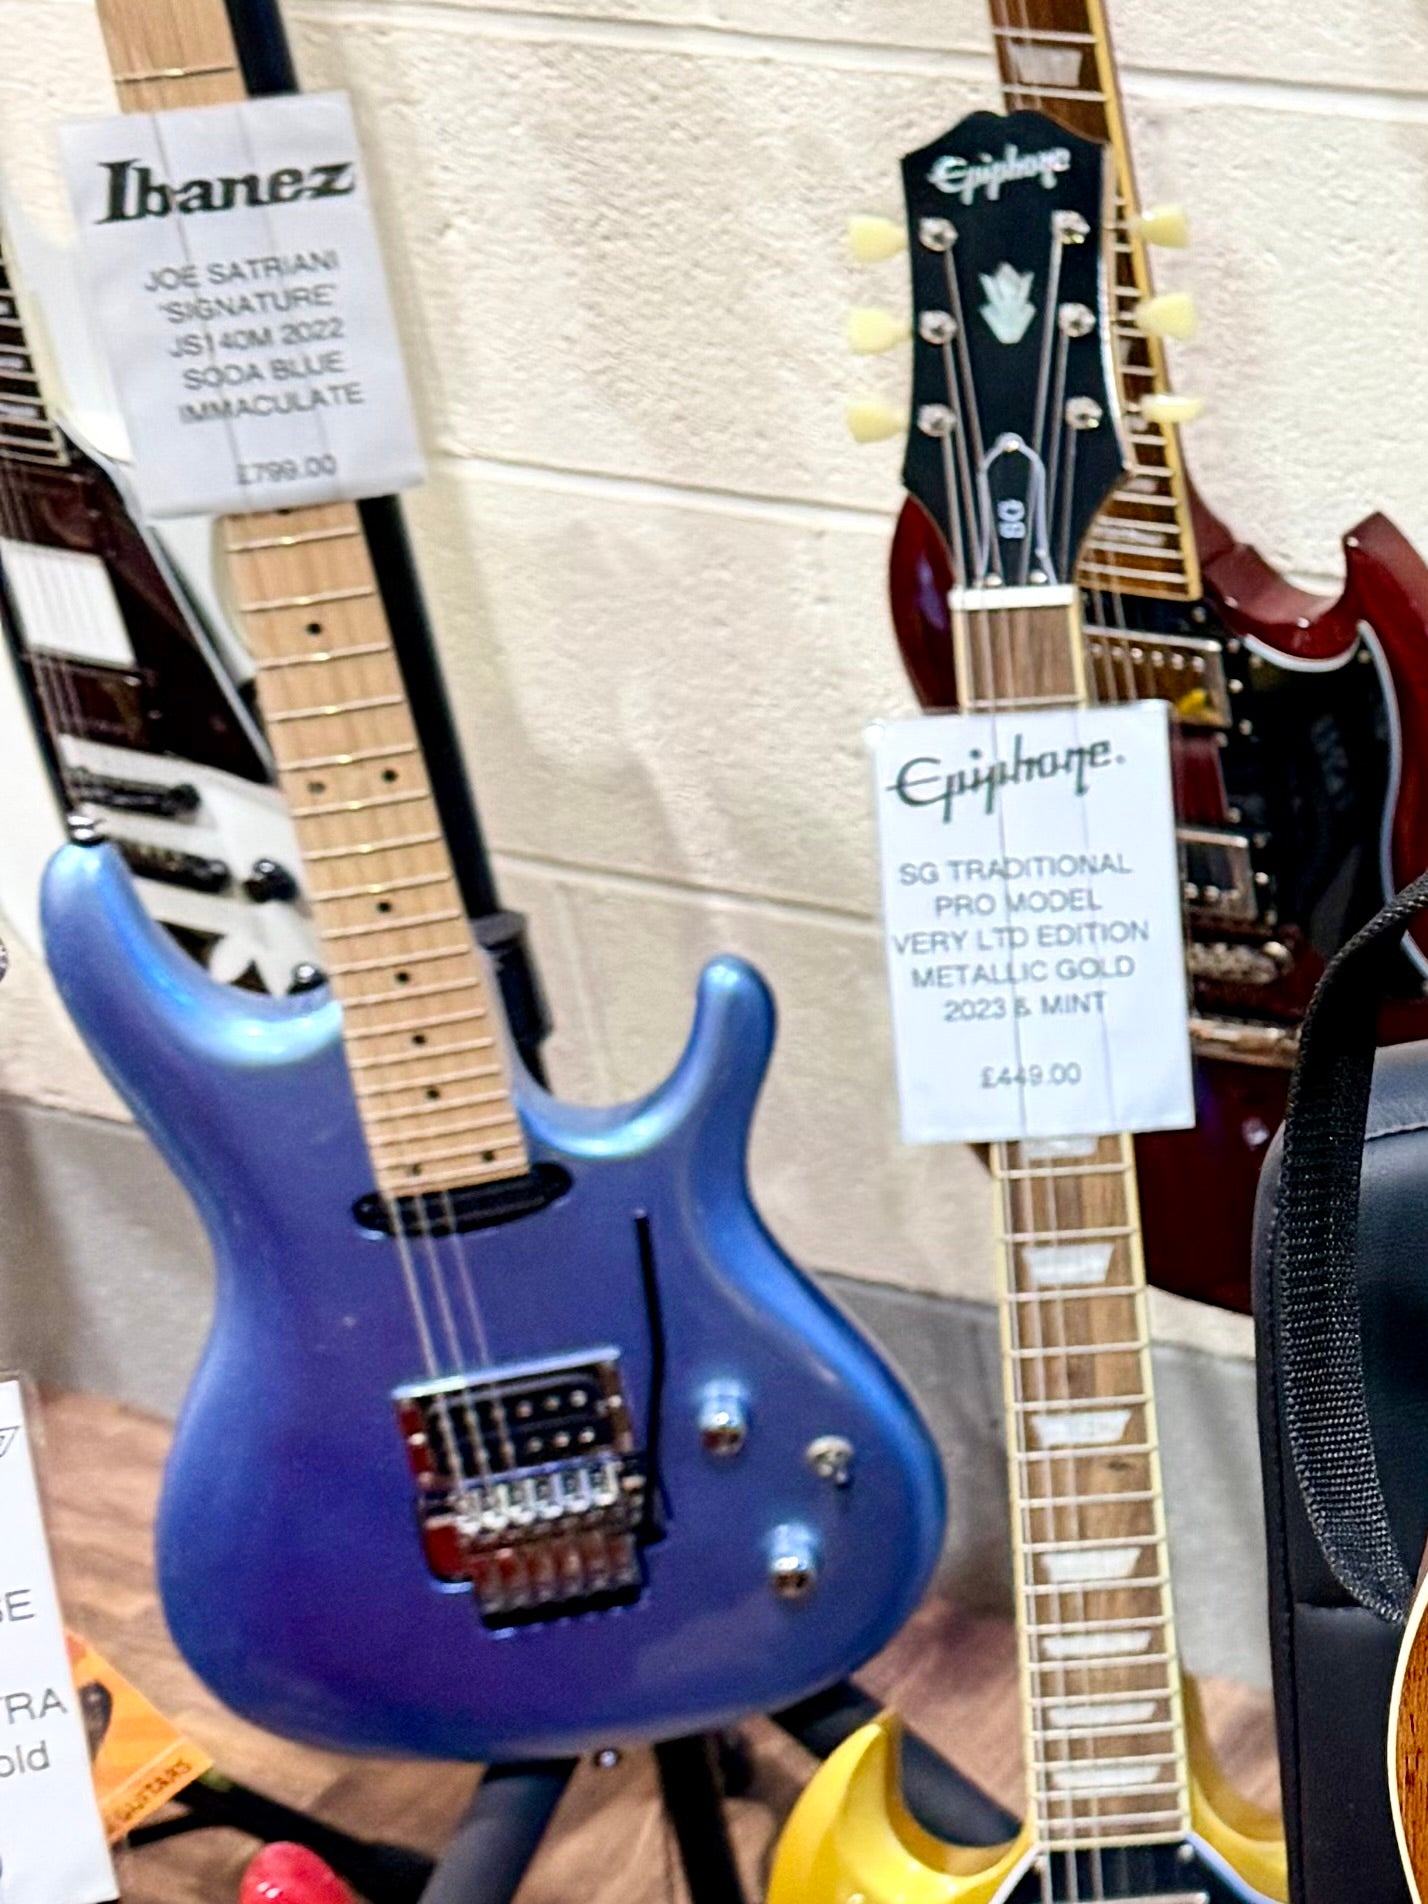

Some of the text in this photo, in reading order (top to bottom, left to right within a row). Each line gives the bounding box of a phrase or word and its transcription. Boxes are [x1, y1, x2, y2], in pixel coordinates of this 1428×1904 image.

[94, 158, 358, 225] Ibanez
[927, 142, 1072, 205] Epiphone
[144, 250, 340, 293] JOE SATRIANI
[280, 316, 345, 346] 2022
[182, 350, 348, 391] SODA BLUE
[178, 381, 365, 425] IMMACULATE
[898, 852, 1134, 886] SG TRADITIONAL
[934, 887, 1104, 918] PRO MODEL
[893, 919, 1150, 956] VERY LTD EDITION
[911, 954, 1136, 988] METALLIC GOLD
[943, 996, 1007, 1022] 2023
[1040, 990, 1107, 1015] MINT
